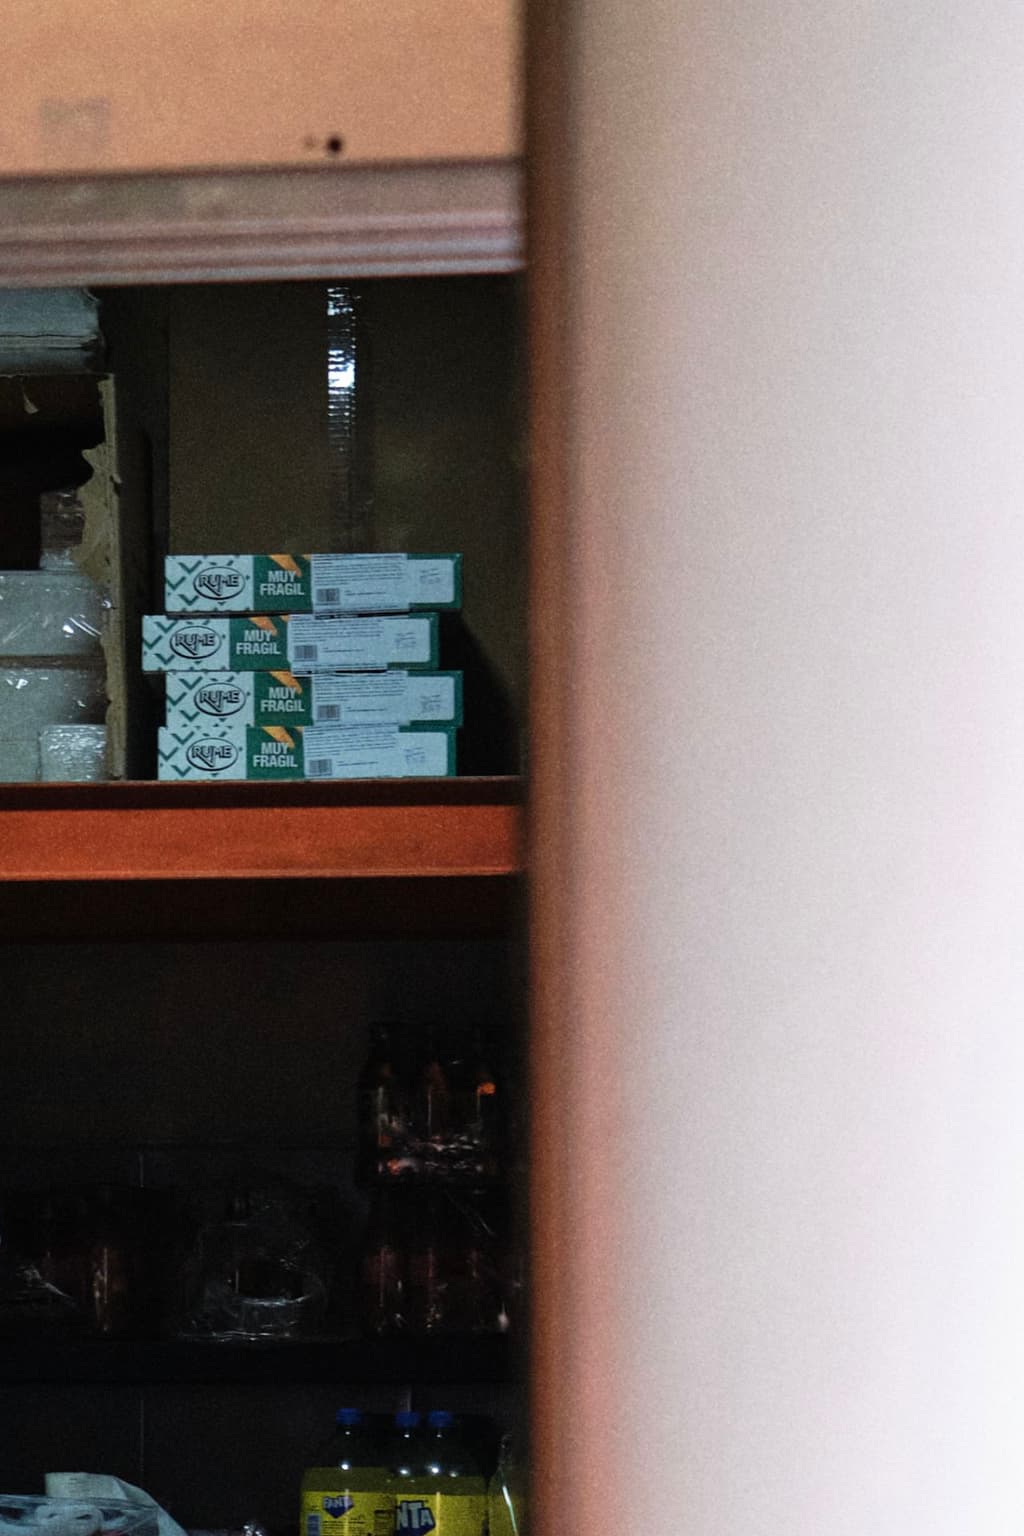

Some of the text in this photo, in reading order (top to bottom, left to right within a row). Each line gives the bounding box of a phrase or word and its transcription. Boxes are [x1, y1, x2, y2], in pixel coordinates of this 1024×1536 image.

[267, 571, 295, 583] MUY
[259, 583, 305, 596] FRAGIL
[244, 630, 272, 642] MUY
[236, 642, 281, 655] FRAGIL
[269, 687, 296, 699] MUY
[260, 699, 305, 712] FRAGIL
[261, 742, 289, 754] MUY
[252, 754, 298, 767] FRAGIL
[396, 1501, 434, 1530] NTA
